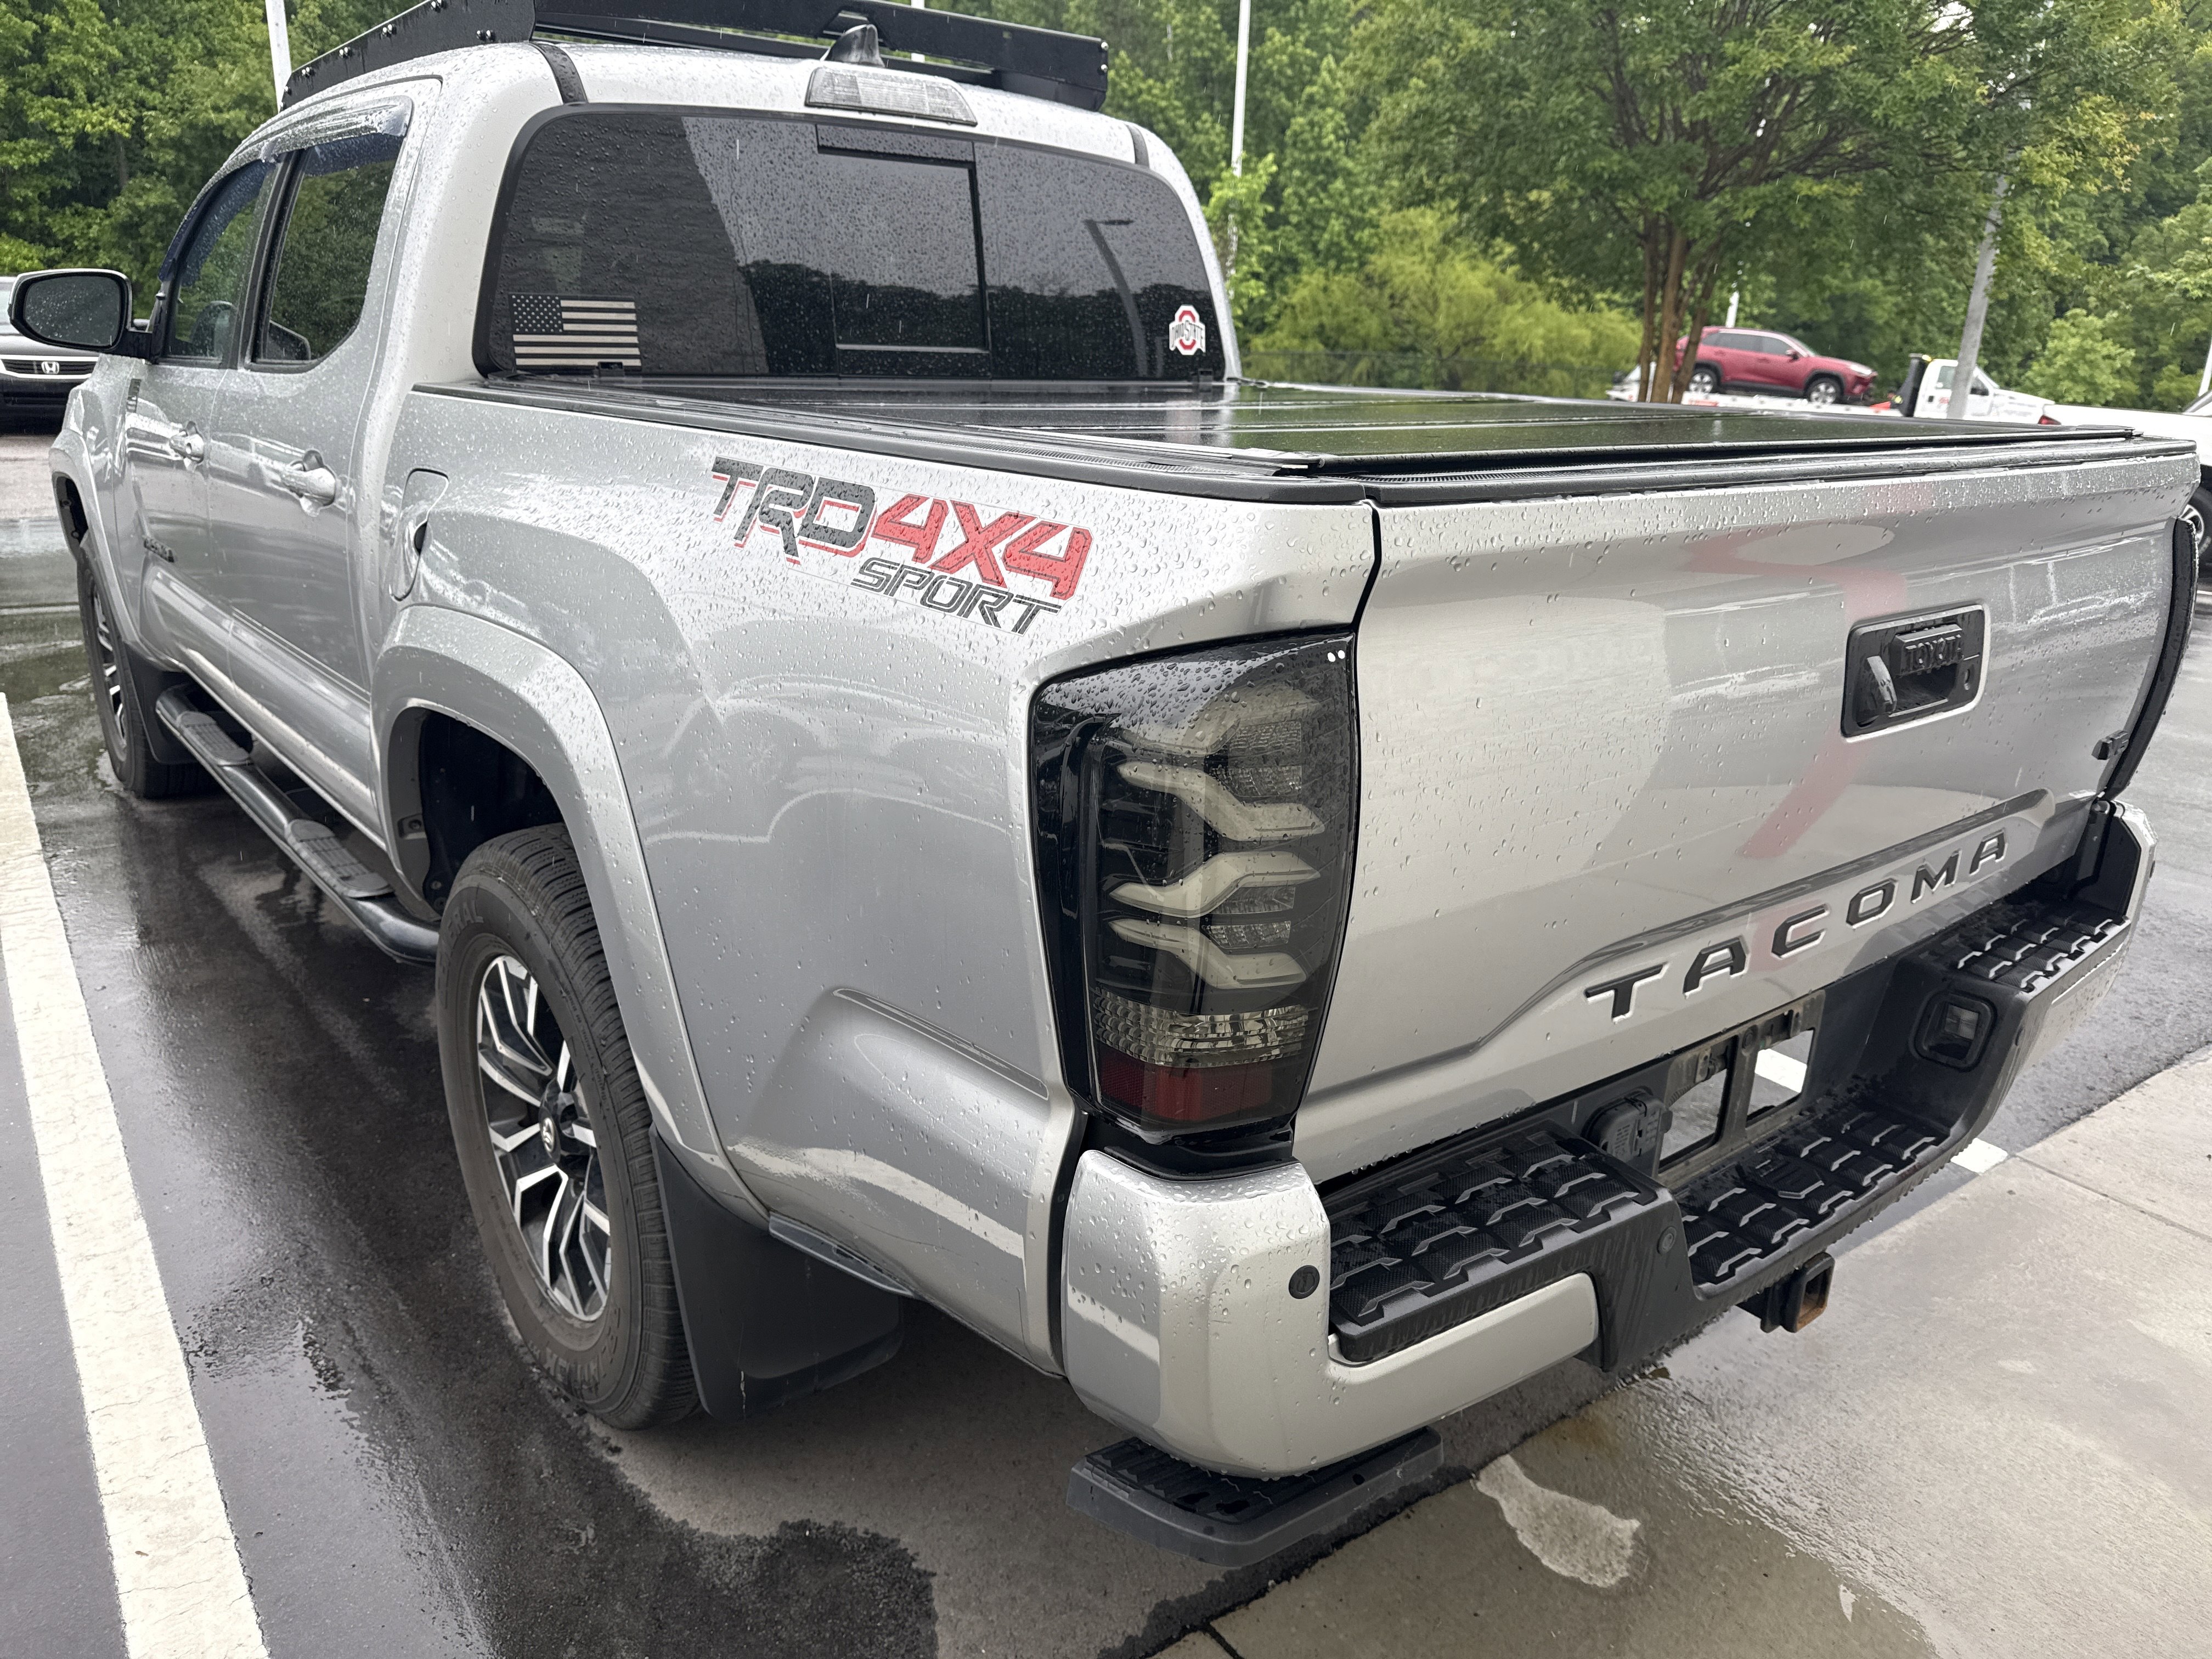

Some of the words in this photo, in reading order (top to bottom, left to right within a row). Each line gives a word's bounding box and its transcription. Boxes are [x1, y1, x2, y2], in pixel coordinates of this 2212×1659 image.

[712, 456, 877, 566] TRD
[871, 493, 1093, 600] 4X4
[850, 557, 1062, 635] SPORT
[1584, 828, 2007, 1023] TACOMA
